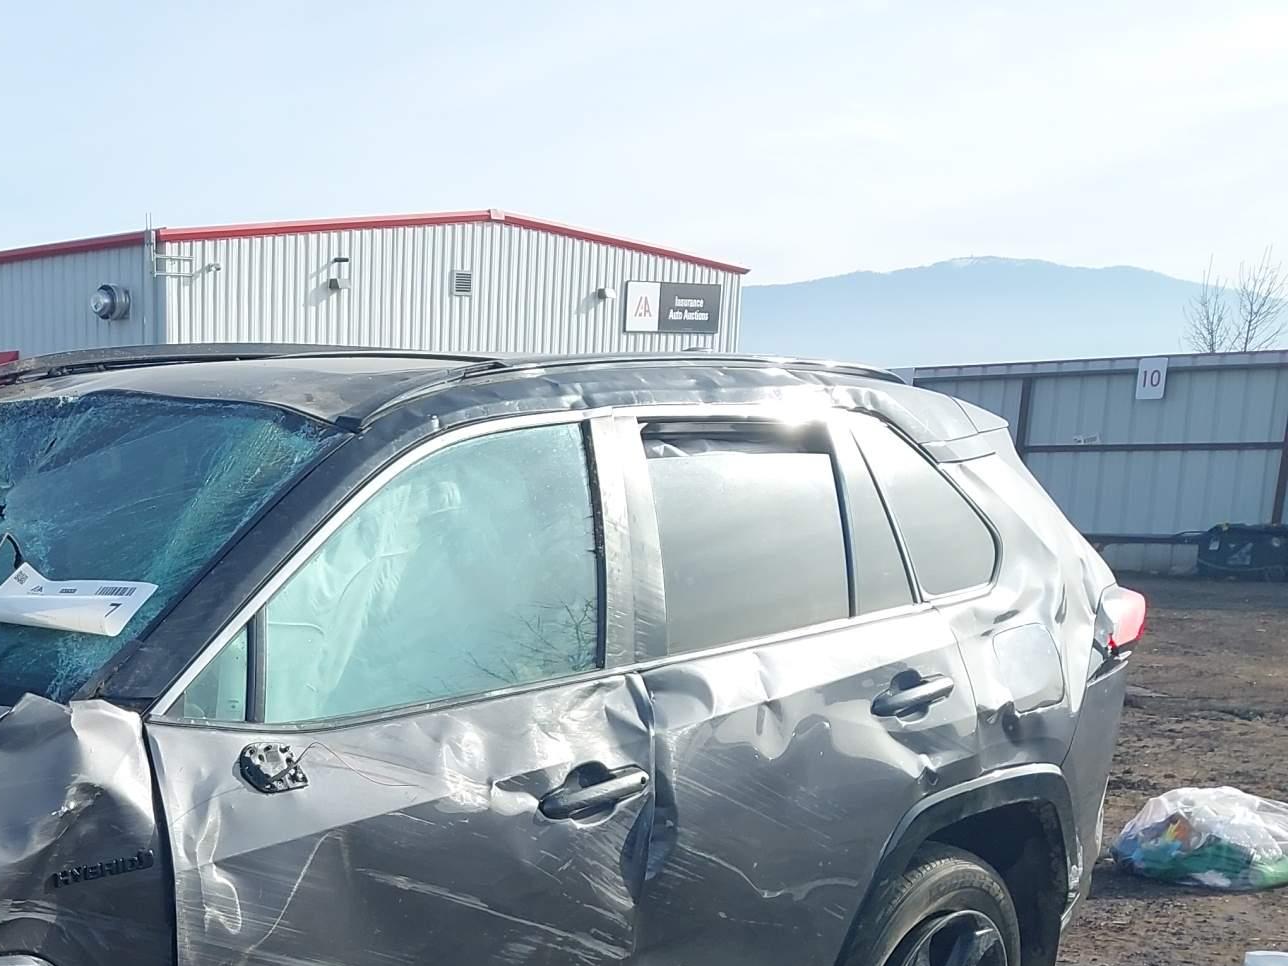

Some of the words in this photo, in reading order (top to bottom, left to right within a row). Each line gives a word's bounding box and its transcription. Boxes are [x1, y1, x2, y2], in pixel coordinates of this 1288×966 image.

[675, 296, 704, 308] Insurance
[668, 309, 683, 320] Auto
[683, 309, 709, 320] Auctions
[1143, 369, 1161, 388] 10
[104, 602, 122, 618] 7
